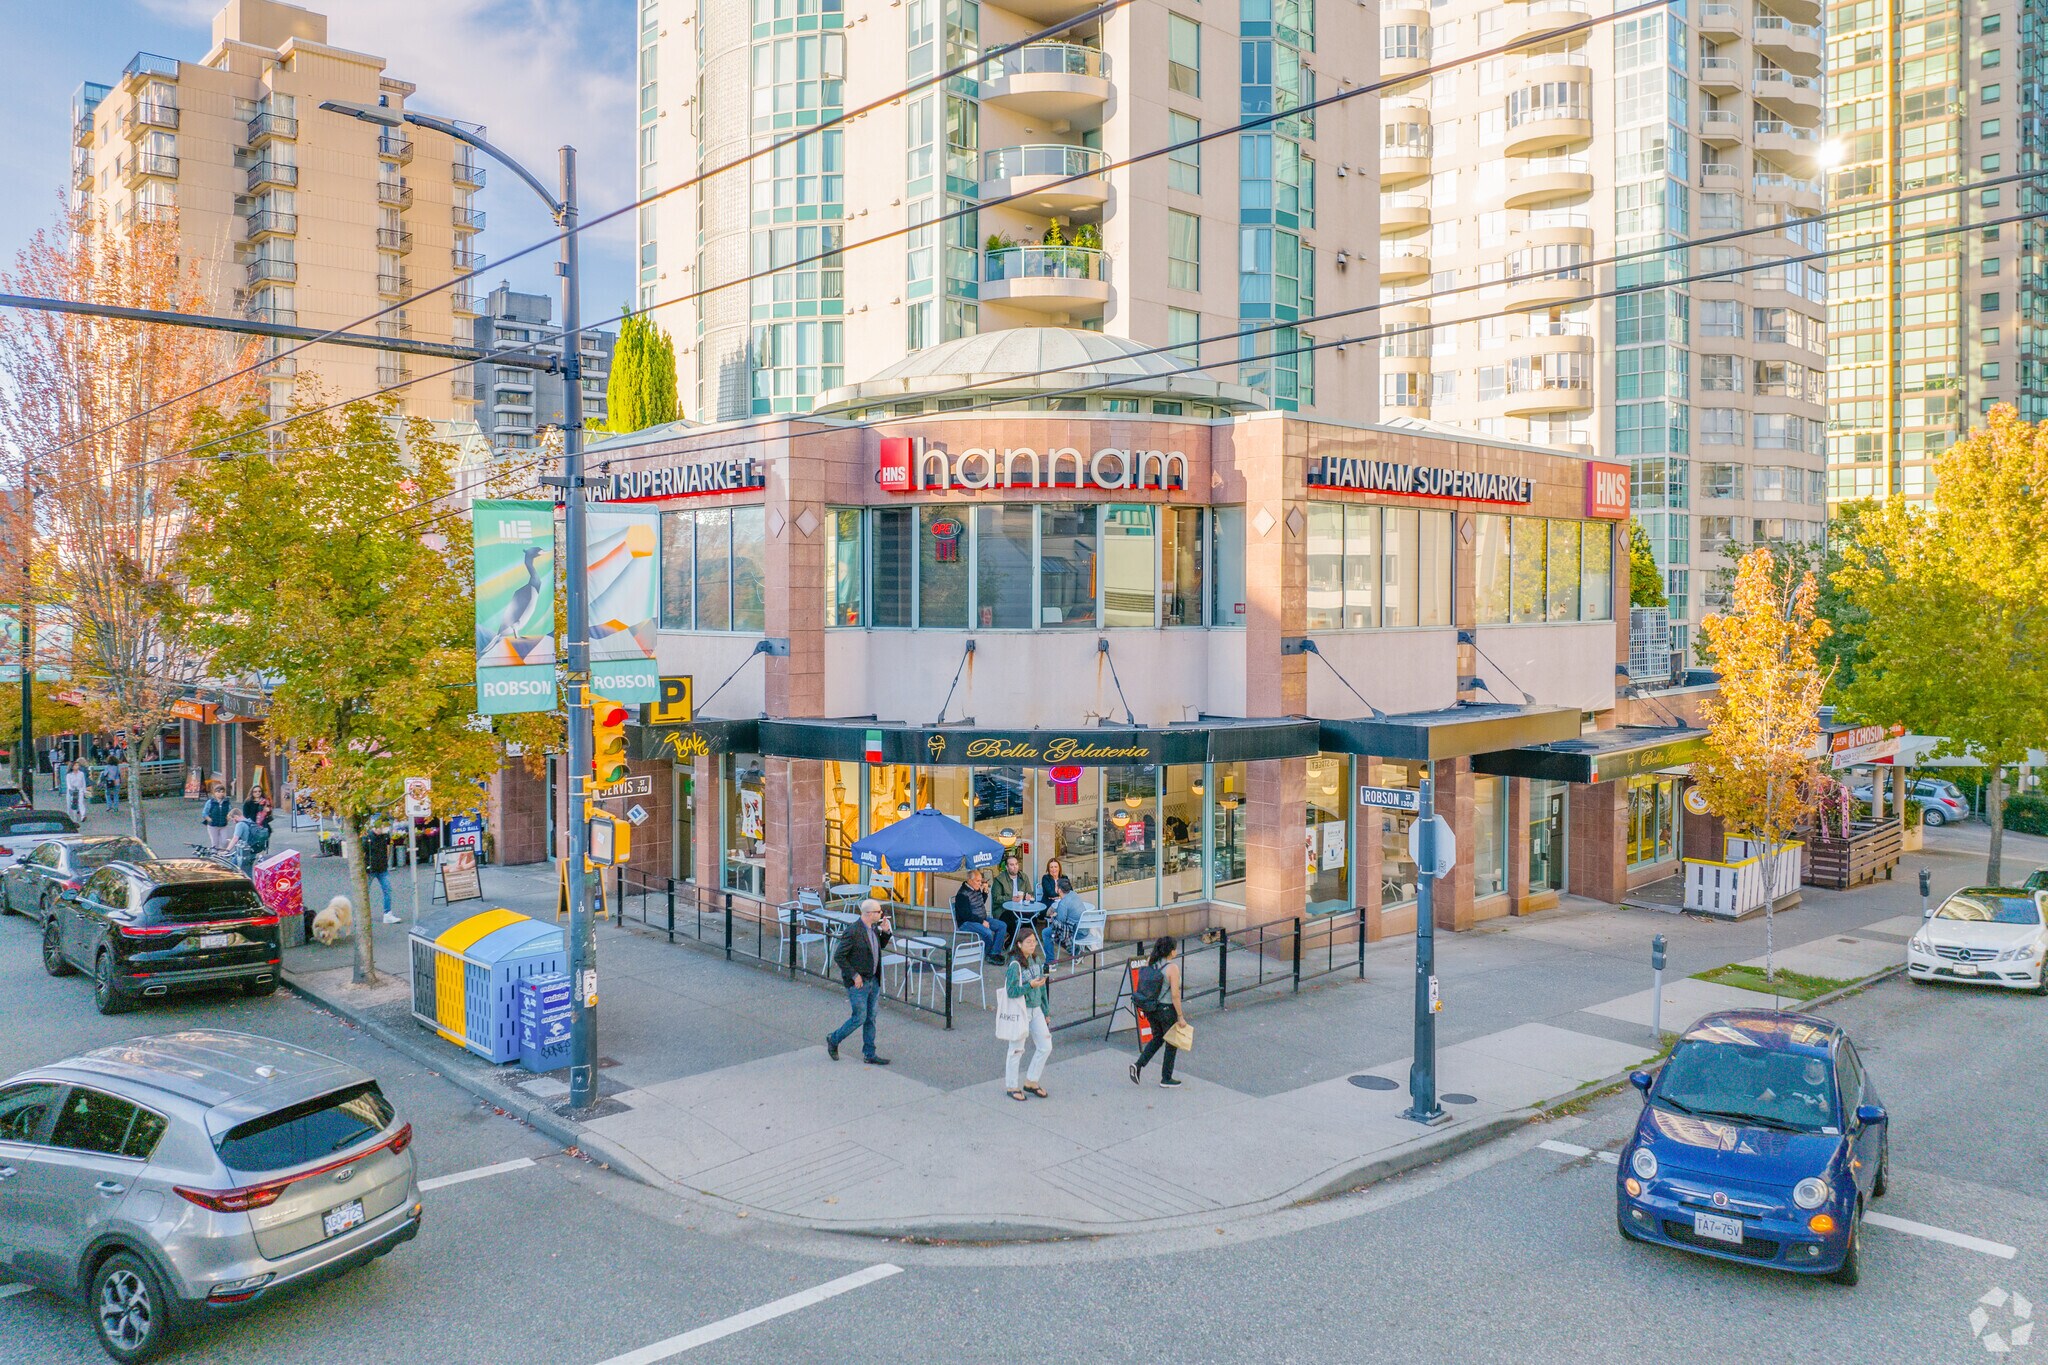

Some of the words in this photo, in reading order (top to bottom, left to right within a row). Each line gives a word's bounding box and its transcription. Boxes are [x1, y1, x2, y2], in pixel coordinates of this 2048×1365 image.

[917, 437, 1188, 490] hannam
[620, 458, 751, 499] SUPERMARKET
[883, 466, 906, 482] HNS
[1326, 456, 1413, 492] HANNAM
[1417, 466, 1537, 502] SUPERMARKET
[1597, 471, 1626, 507] HNS
[932, 522, 959, 535] OPEN
[483, 680, 551, 697] ROBSON
[594, 674, 655, 690] ROBSON
[659, 680, 687, 715] P
[1856, 723, 1884, 746] CHOSUN
[966, 738, 1039, 758] Bella
[1042, 737, 1150, 763] Gelateria
[637, 785, 648, 793] 700
[1364, 790, 1399, 805] ROBSON
[904, 855, 943, 867] LAVAZZA
